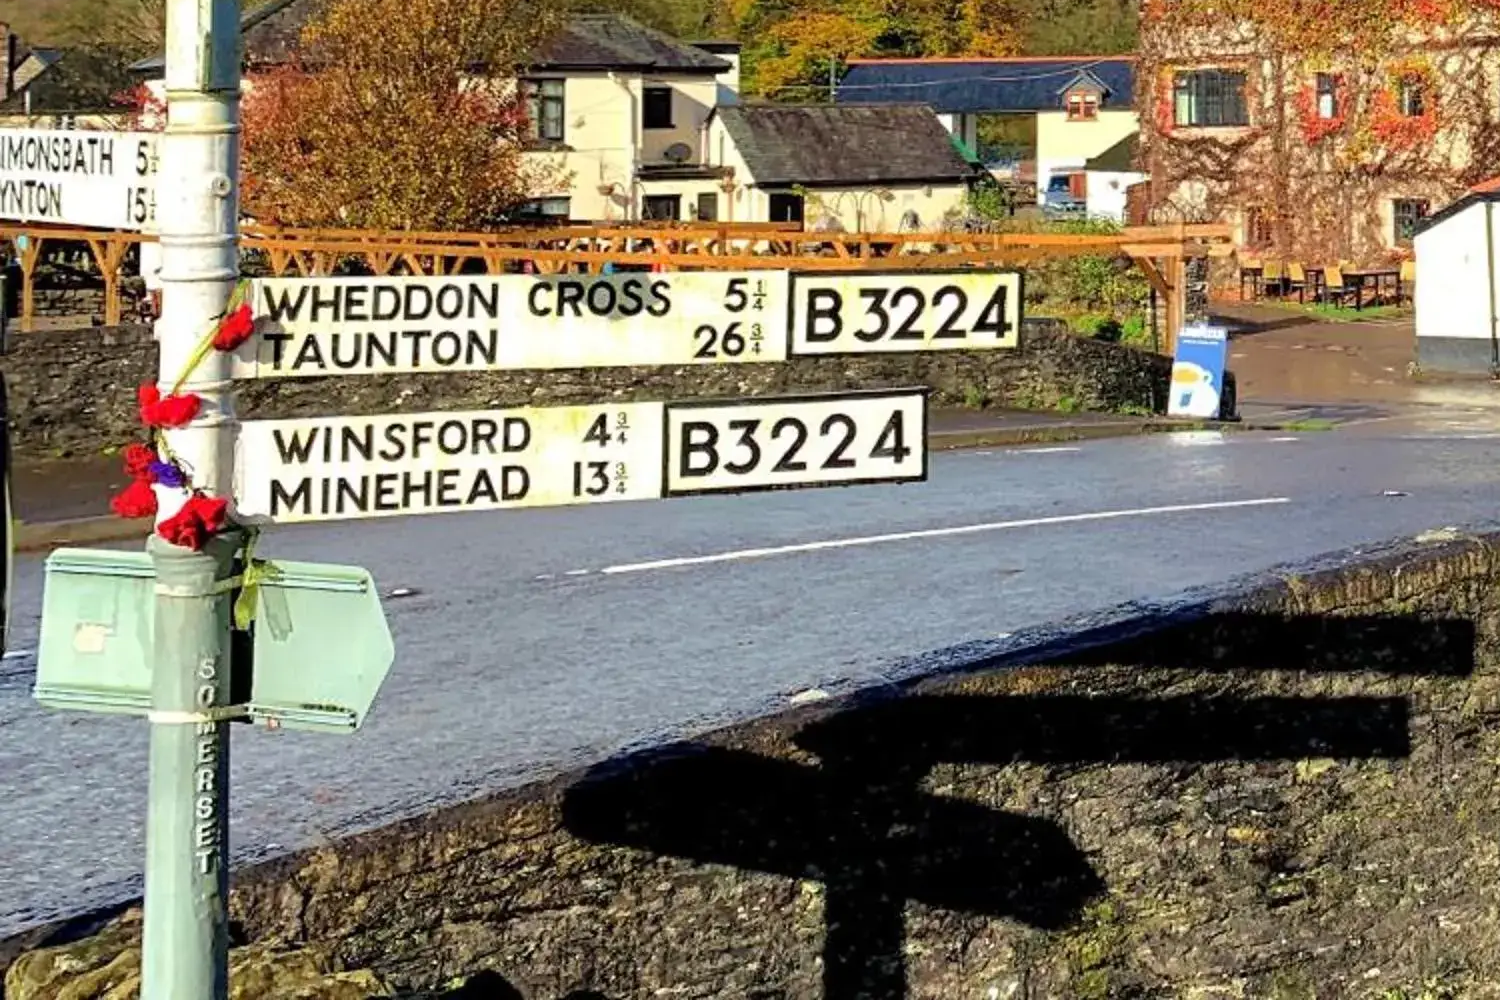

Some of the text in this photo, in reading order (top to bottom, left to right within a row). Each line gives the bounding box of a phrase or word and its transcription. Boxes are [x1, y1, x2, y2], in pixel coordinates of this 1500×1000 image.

[263, 283, 499, 323] WHEDDON
[528, 279, 671, 317] CROSS
[805, 285, 1012, 343] B3224
[263, 330, 498, 370] TAUNTON
[272, 417, 532, 464] WINSFORD
[680, 410, 912, 478] B3224
[269, 465, 531, 516] MINEHEAD
[195, 658, 217, 874] SOMERSET
